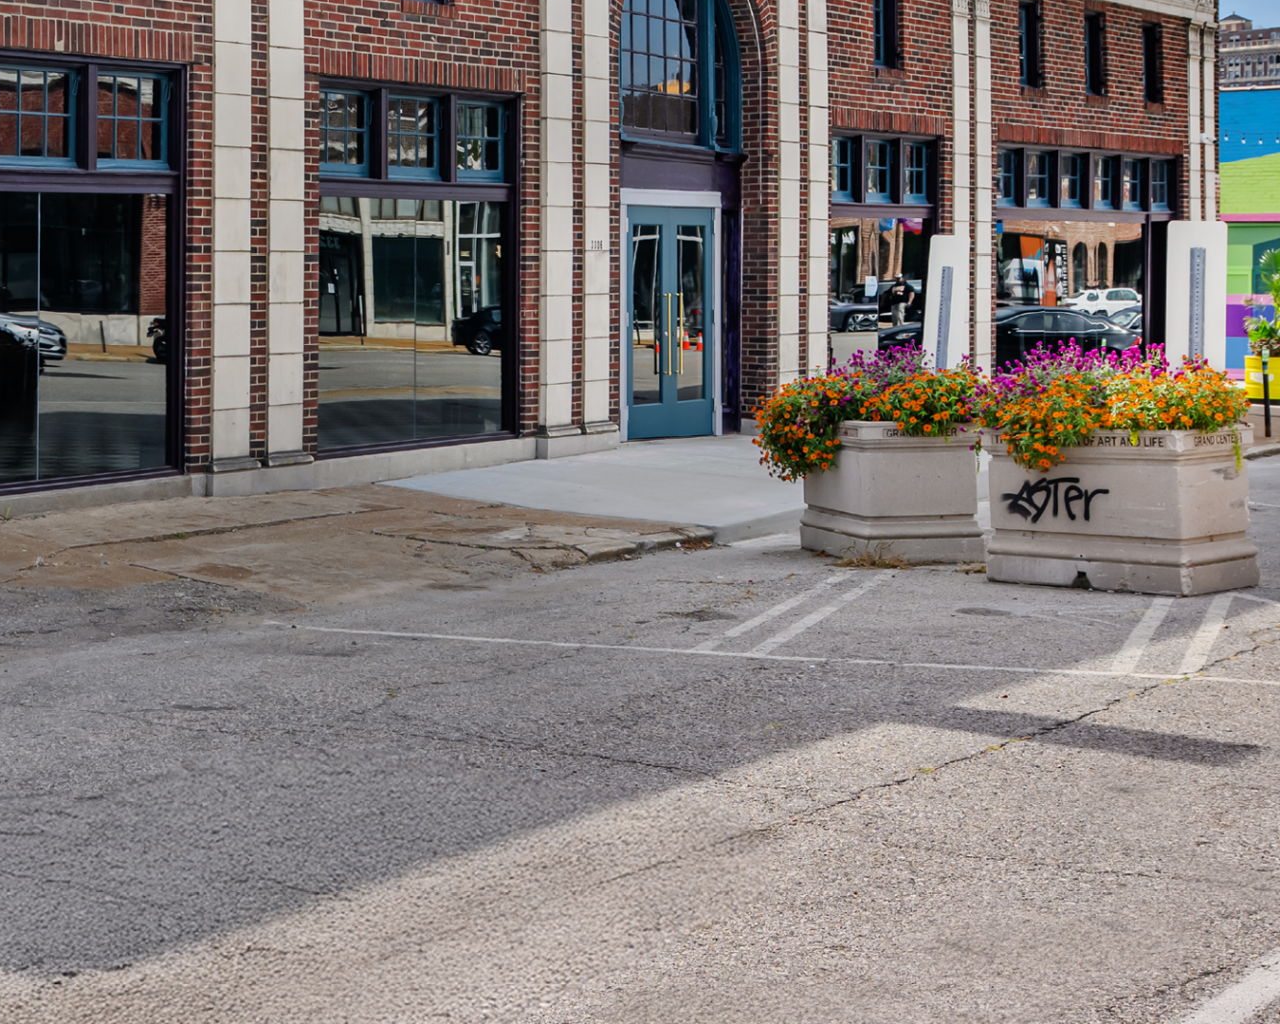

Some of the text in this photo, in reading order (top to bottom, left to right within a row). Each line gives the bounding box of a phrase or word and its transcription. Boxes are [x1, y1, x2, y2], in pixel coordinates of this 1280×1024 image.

[1082, 436, 1095, 446] OF
[1097, 436, 1117, 446] ART
[1143, 437, 1165, 447] LIFE
[1193, 436, 1215, 447] GRAND
